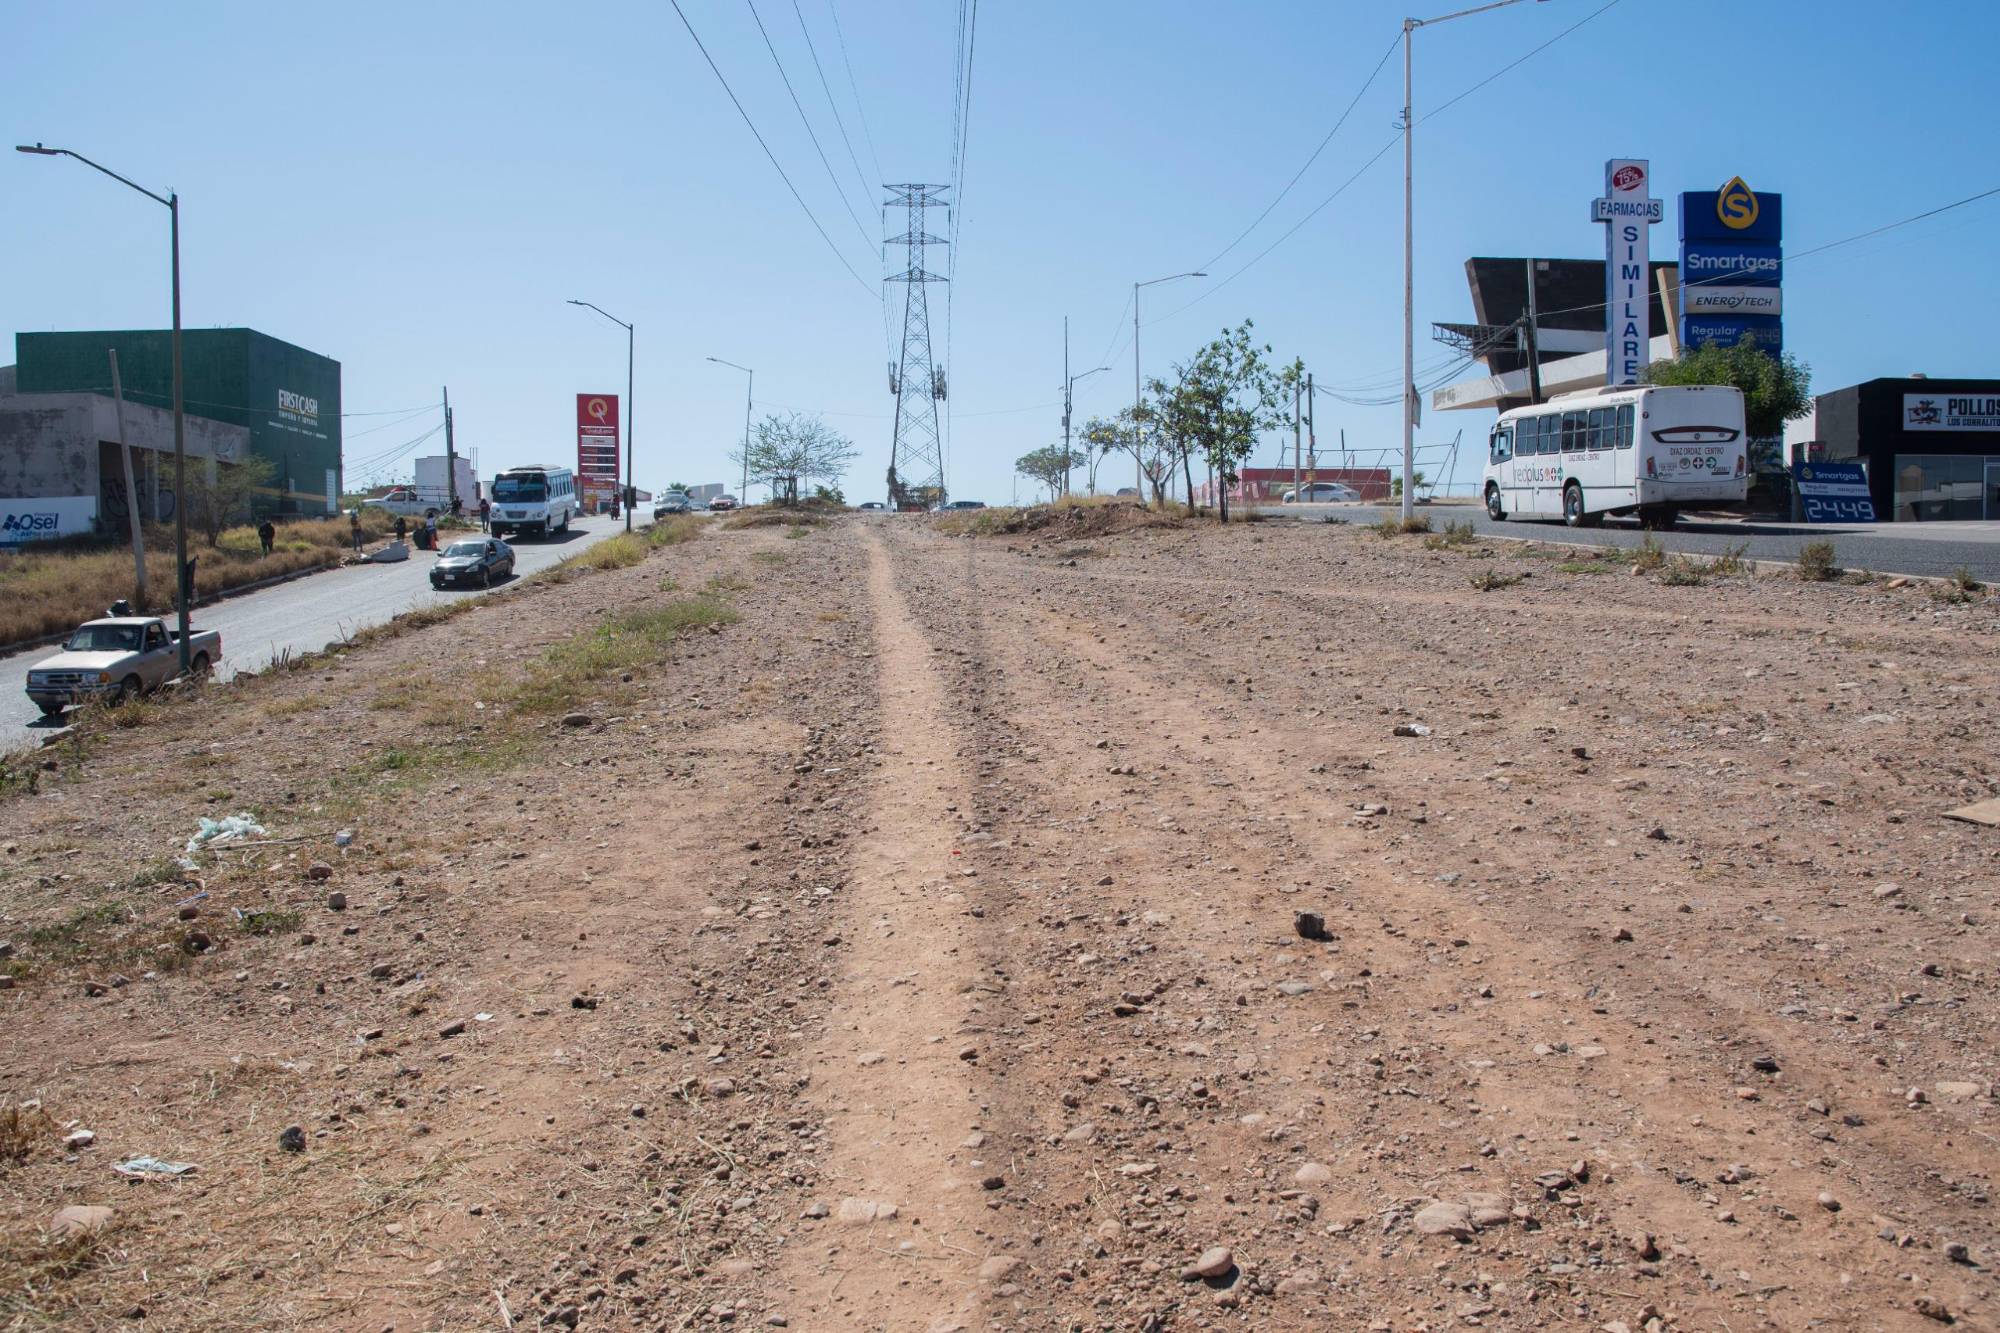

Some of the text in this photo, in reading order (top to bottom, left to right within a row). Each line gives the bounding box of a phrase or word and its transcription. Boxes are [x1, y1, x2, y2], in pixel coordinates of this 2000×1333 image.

[1616, 170, 1639, 185] 75%
[1600, 201, 1660, 217] FARMACIAS
[1687, 253, 1778, 272] Smartgas
[1696, 295, 1773, 308] ENERGYTECH
[1691, 325, 1737, 336] Regular
[1683, 447, 1702, 455] ORDAZ
[1704, 447, 1724, 455] CENTRO
[1815, 471, 1860, 481] Smartgas
[1808, 499, 1875, 520] 24.49
[19, 512, 59, 530] Osel
